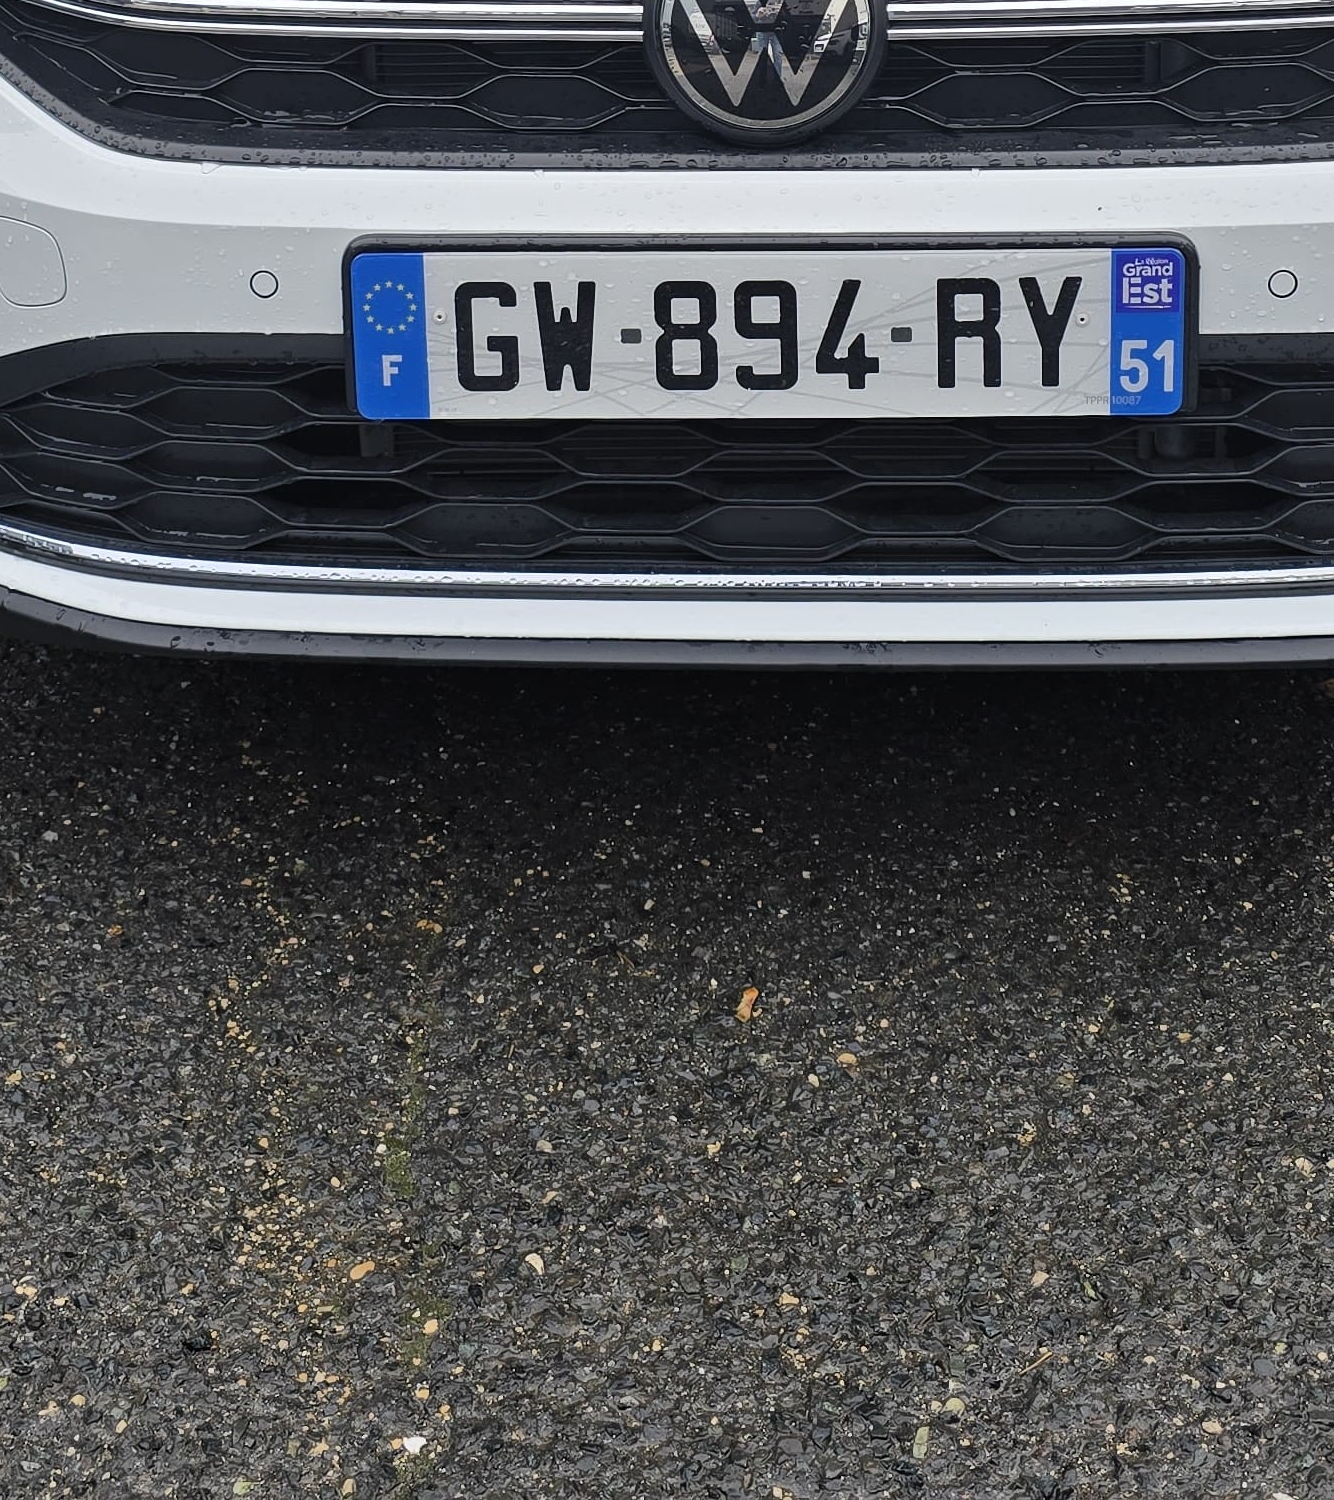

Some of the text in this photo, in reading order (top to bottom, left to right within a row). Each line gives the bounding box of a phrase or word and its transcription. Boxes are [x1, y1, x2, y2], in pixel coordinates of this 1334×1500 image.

[1122, 261, 1174, 277] Grand
[1122, 277, 1173, 304] Est
[454, 276, 1082, 392] GW-894-RY
[381, 354, 403, 387] F
[1119, 339, 1175, 393] 51
